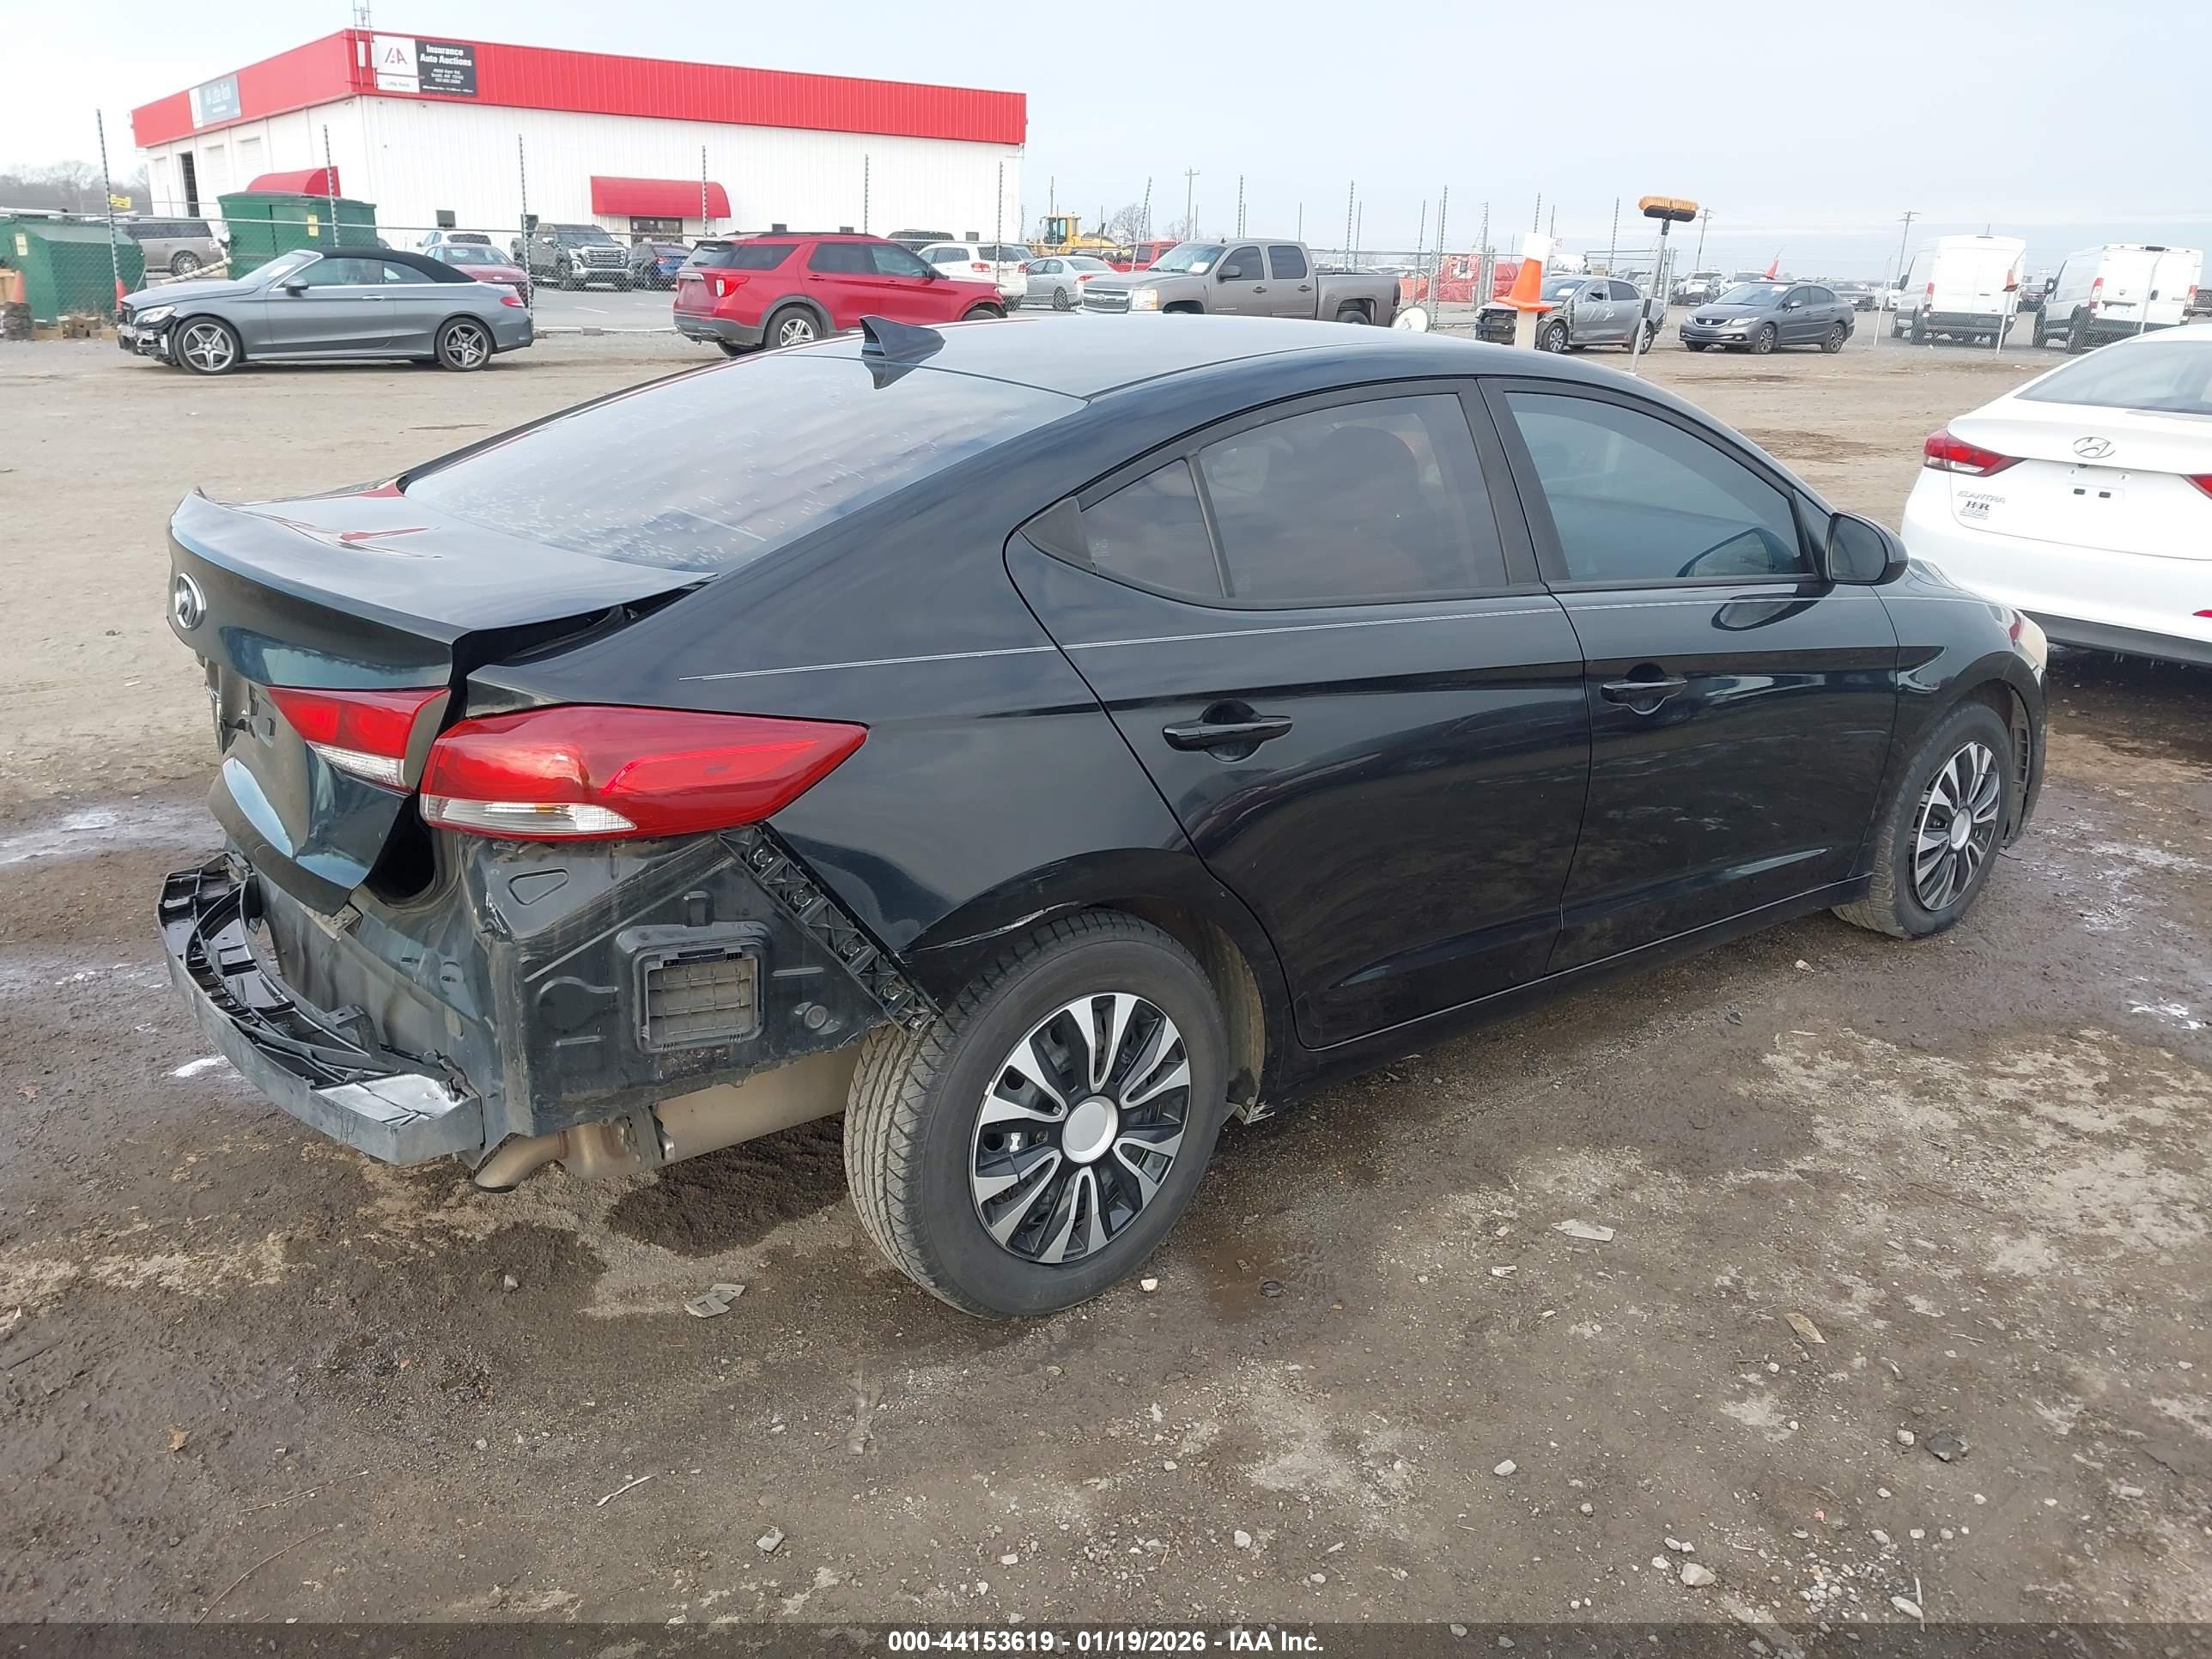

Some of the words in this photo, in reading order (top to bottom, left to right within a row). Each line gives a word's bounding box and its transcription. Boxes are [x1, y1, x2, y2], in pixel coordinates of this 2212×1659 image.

[426, 45, 464, 57] Insurance
[420, 53, 438, 64] Auto
[439, 55, 472, 66] Auctions
